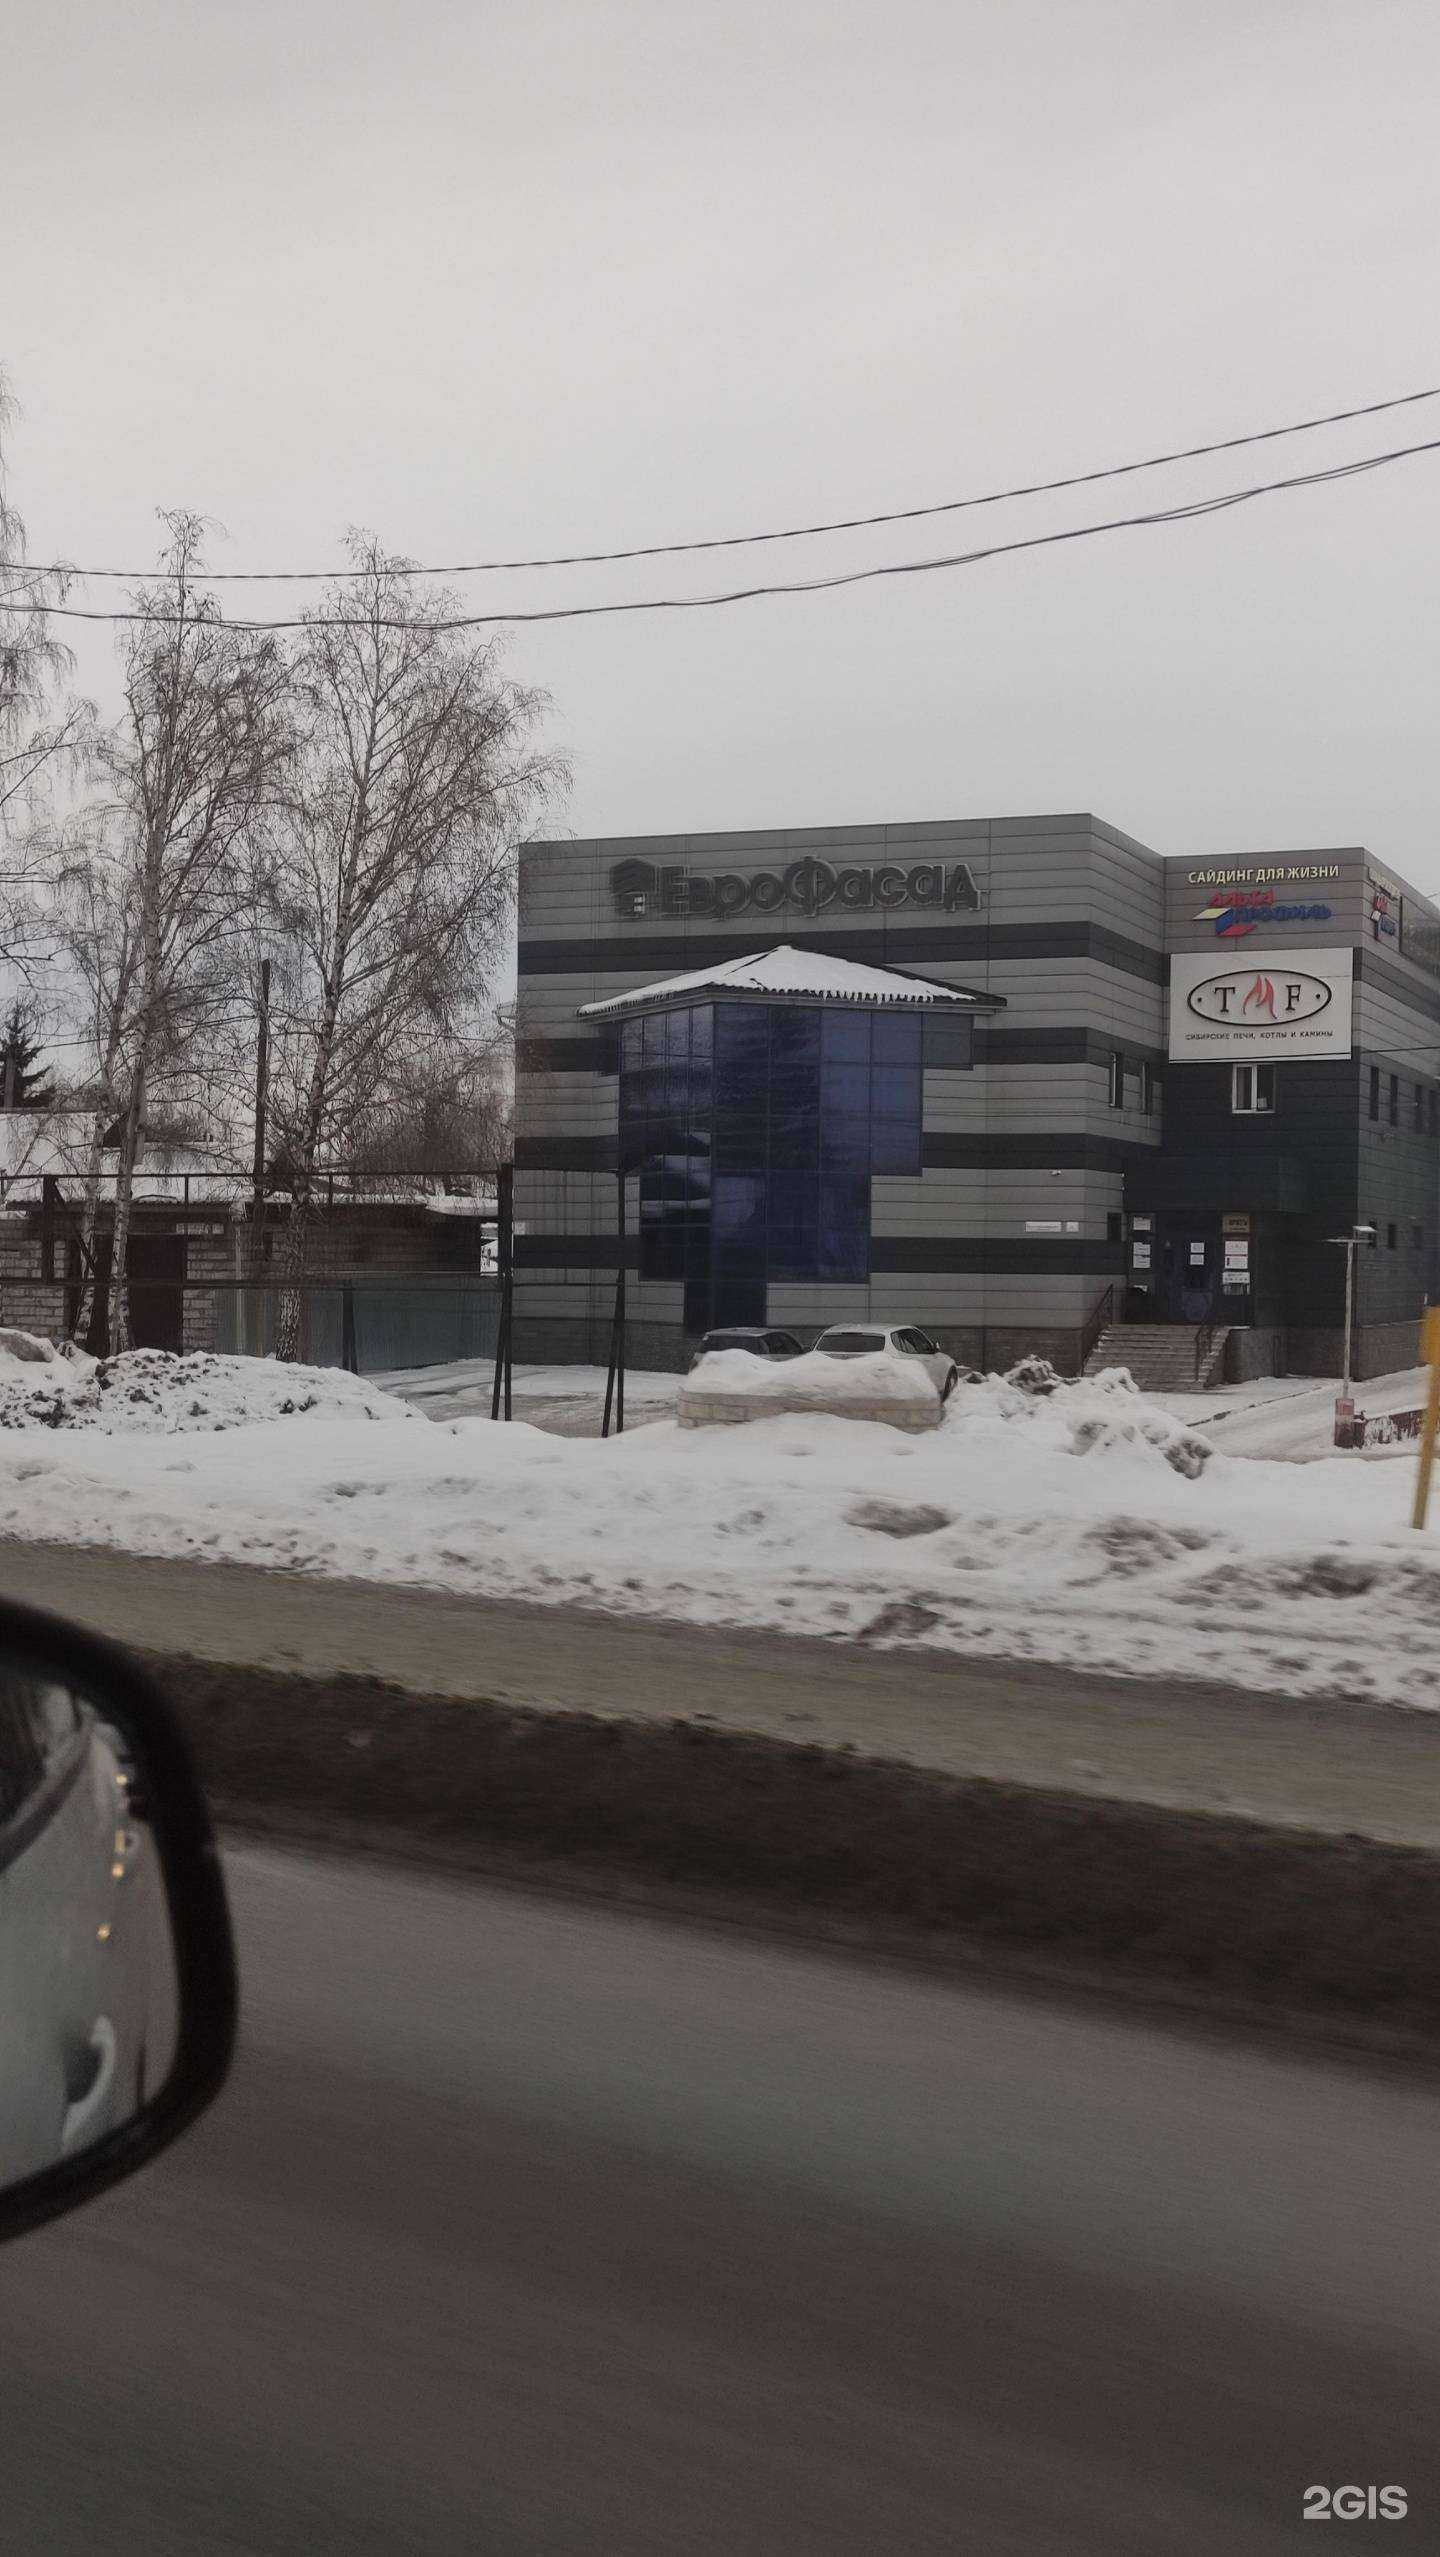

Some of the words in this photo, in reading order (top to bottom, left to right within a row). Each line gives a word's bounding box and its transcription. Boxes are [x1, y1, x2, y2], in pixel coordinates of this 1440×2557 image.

[1188, 869, 1254, 884] САЙДИНГ
[1256, 867, 1284, 883] ДЛЯ
[1287, 865, 1339, 879] ЖИЗНИ
[1260, 1031, 1287, 1039] КОТЛЫ
[1300, 1030, 1333, 1038] КАМИНЫ
